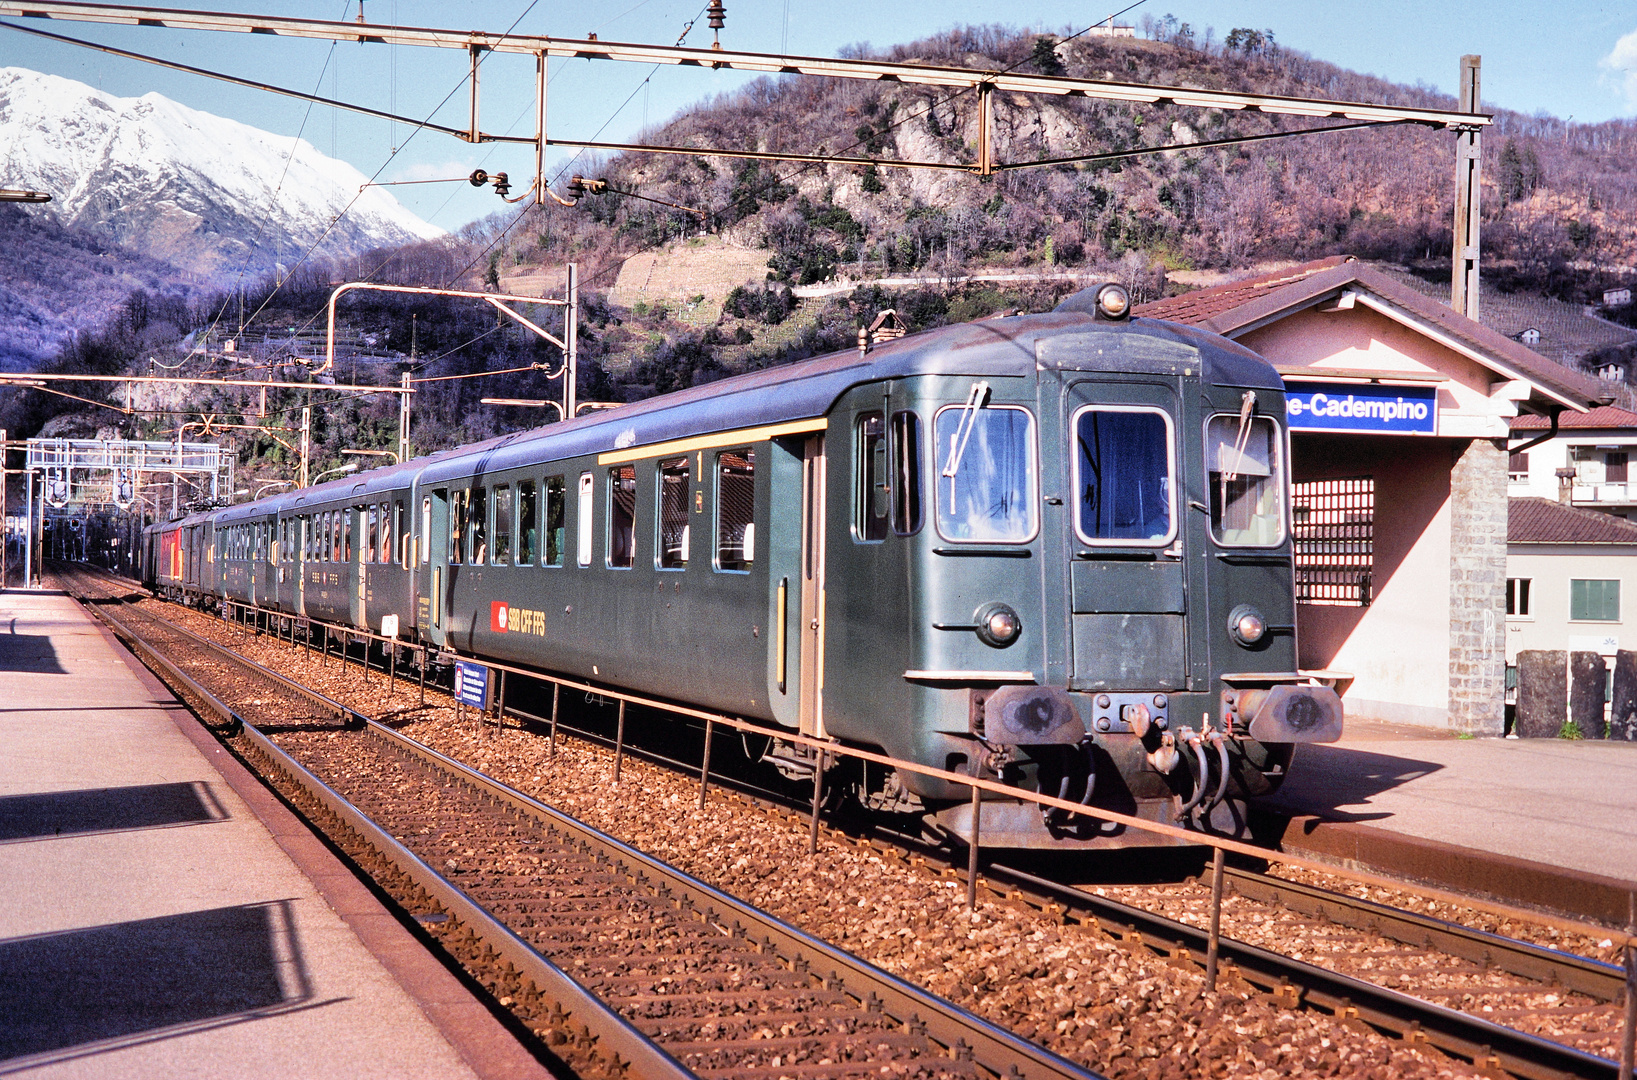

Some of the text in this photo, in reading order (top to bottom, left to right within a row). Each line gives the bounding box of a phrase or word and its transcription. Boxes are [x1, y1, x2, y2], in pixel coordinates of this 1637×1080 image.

[1286, 393, 1428, 422] e-Cadempino
[508, 607, 545, 637] SBB CFF FFS
